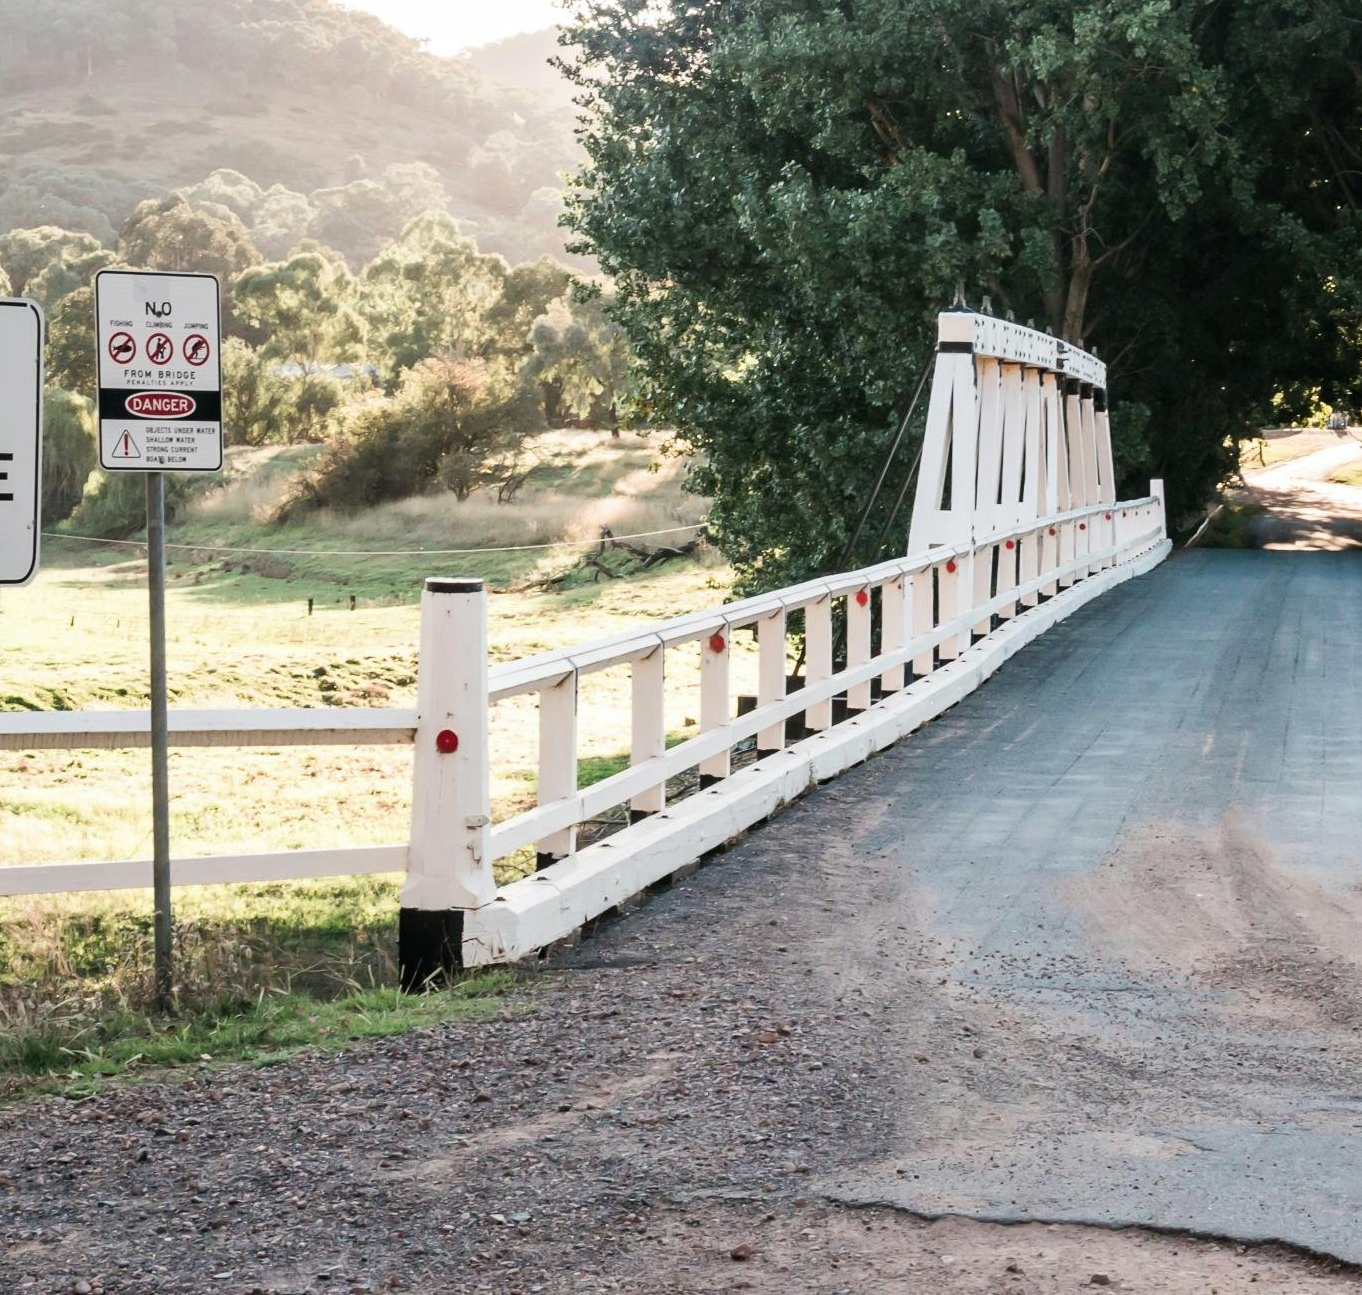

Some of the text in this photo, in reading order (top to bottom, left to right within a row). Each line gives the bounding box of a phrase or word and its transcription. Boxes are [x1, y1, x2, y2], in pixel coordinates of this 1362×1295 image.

[145, 301, 172, 316] NO
[124, 369, 196, 380] FROM BRIDGE
[132, 398, 189, 412] DANGER
[145, 426, 172, 434] OBJECTS
